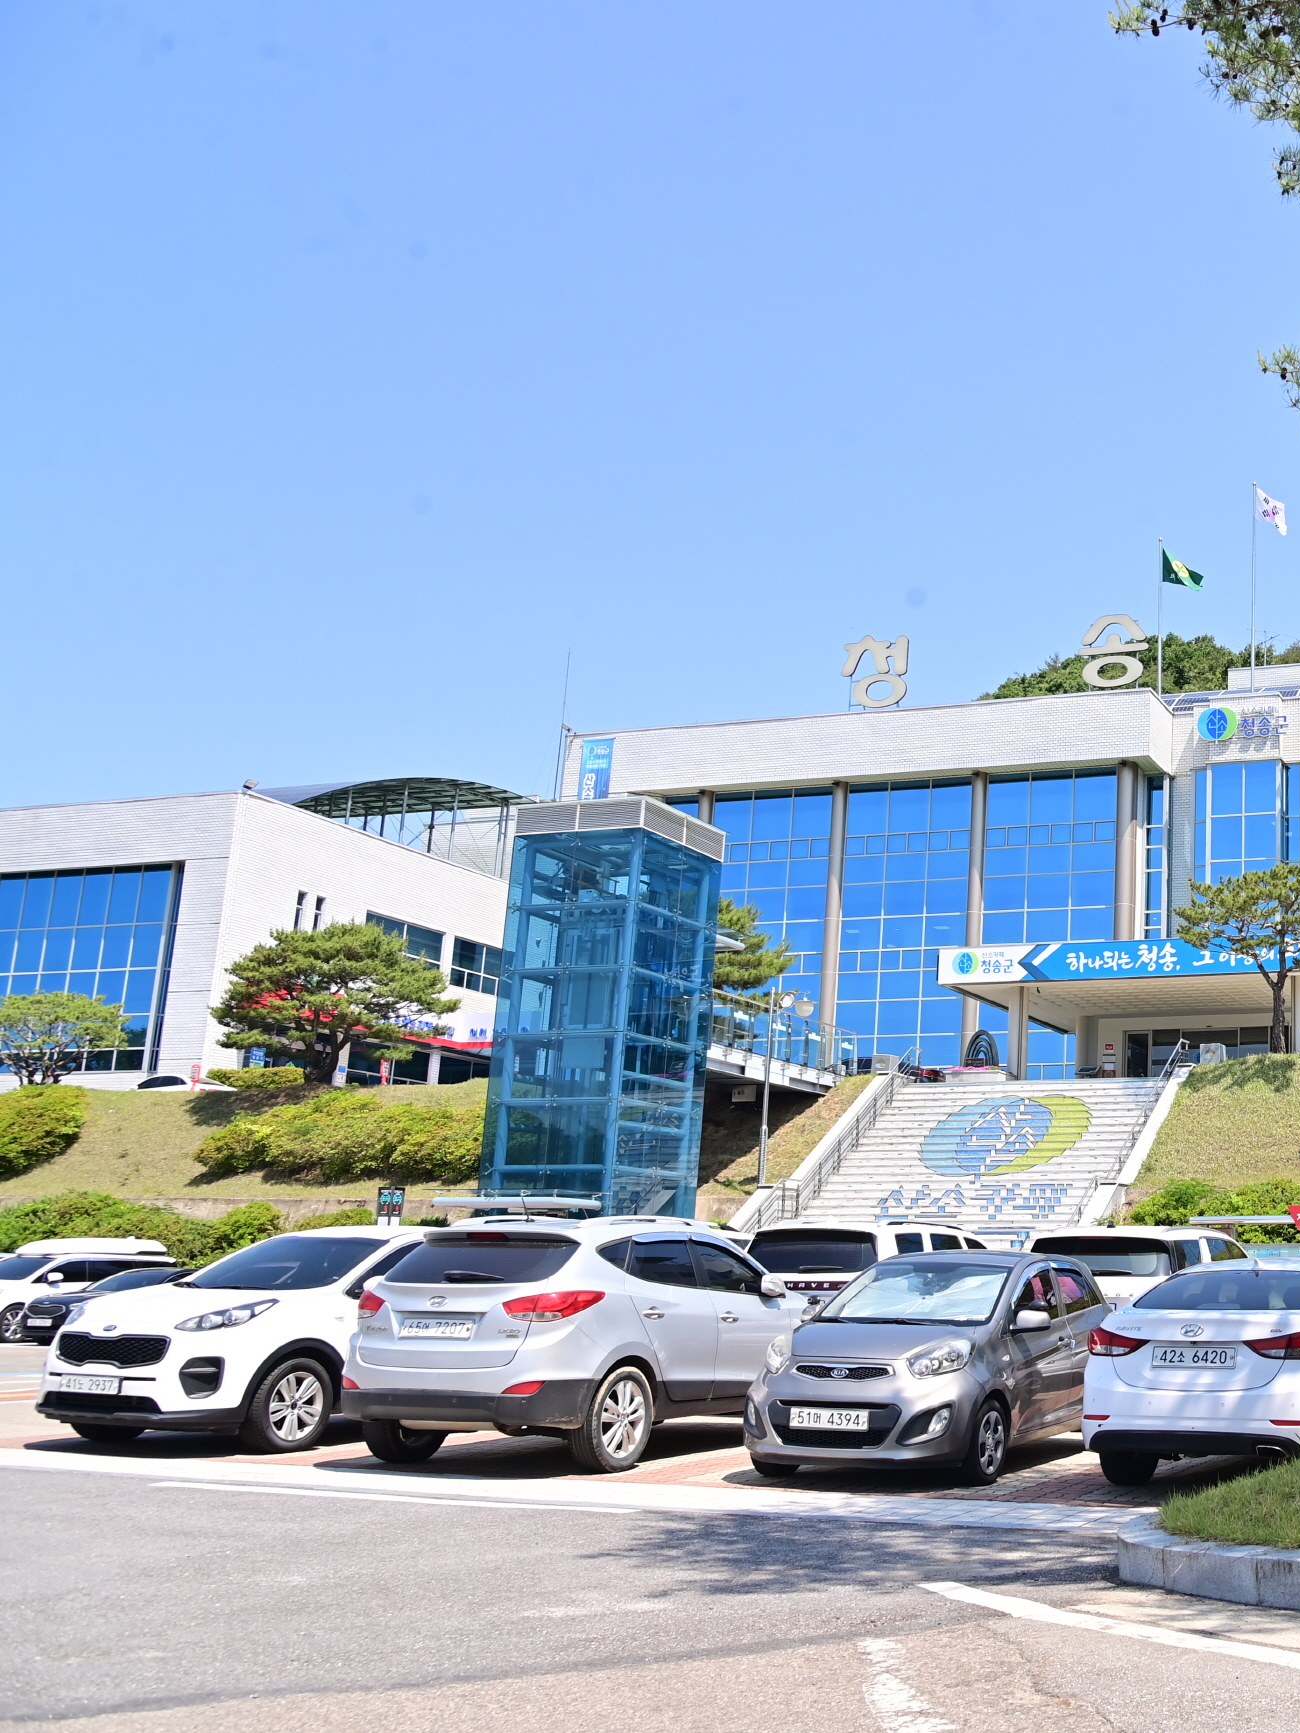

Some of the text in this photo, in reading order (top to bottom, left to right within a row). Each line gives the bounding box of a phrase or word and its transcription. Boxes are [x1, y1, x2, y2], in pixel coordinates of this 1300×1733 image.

[1241, 716, 1289, 738] 청송군
[583, 774, 594, 800] 산소
[980, 959, 1015, 974] 청송군
[1066, 951, 1134, 973] 하나되는
[435, 1321, 466, 1335] 7207
[1159, 1349, 1228, 1364] 42소 6420
[88, 1378, 114, 1392] 2937
[797, 1410, 860, 1427] 51머 4394
